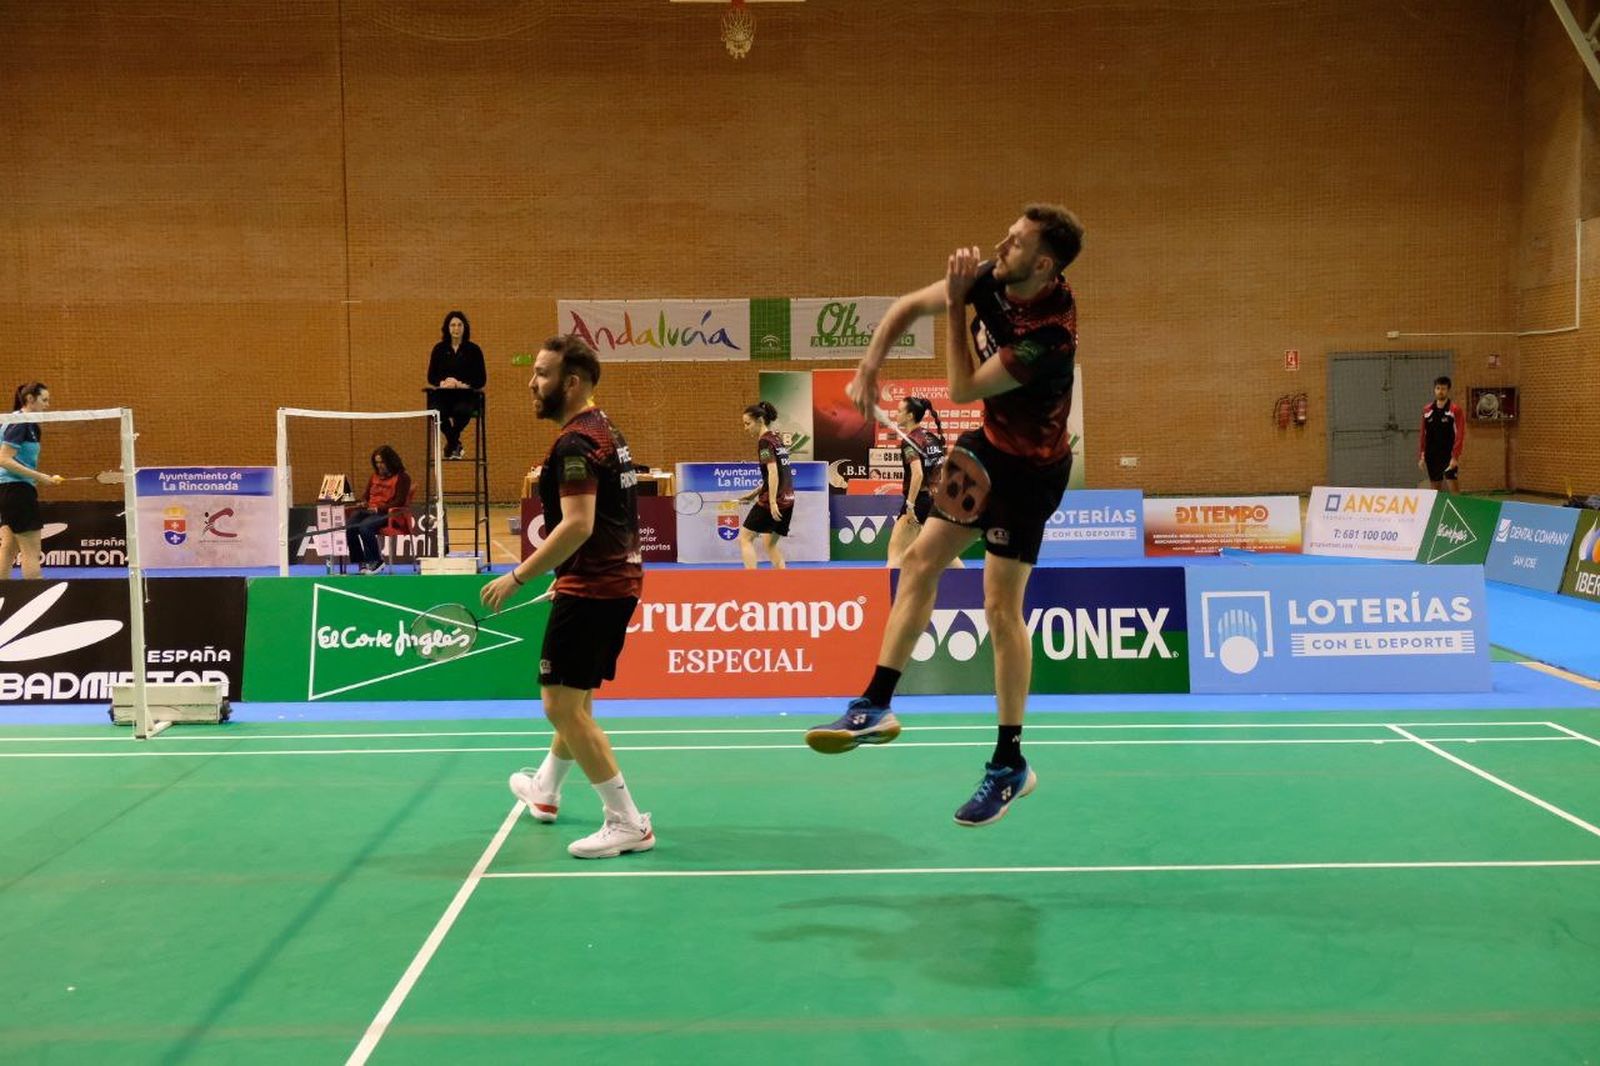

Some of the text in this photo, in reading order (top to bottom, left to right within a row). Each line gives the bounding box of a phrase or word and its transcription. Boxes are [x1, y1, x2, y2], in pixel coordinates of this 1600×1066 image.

[570, 309, 741, 351] Andalucía
[159, 472, 242, 482] Ayuntamiento de
[714, 468, 762, 478] Ayuntami
[163, 481, 239, 491] La Rinconada
[718, 477, 764, 487] La Rinco
[1343, 493, 1419, 514] ANSAN
[1047, 506, 1137, 524] OTERÍAS
[1200, 505, 1268, 523] TEMPO
[81, 537, 125, 547] ESPAÑA
[1333, 529, 1399, 541] T: 681 100 000
[1288, 592, 1473, 625] LOTERÍAS
[317, 626, 339, 649] El
[340, 626, 393, 649] Corte
[1311, 636, 1454, 650] CON EL DEPORTE
[147, 646, 231, 663] ESPAÑA
[668, 648, 812, 674] ESPECIAL
